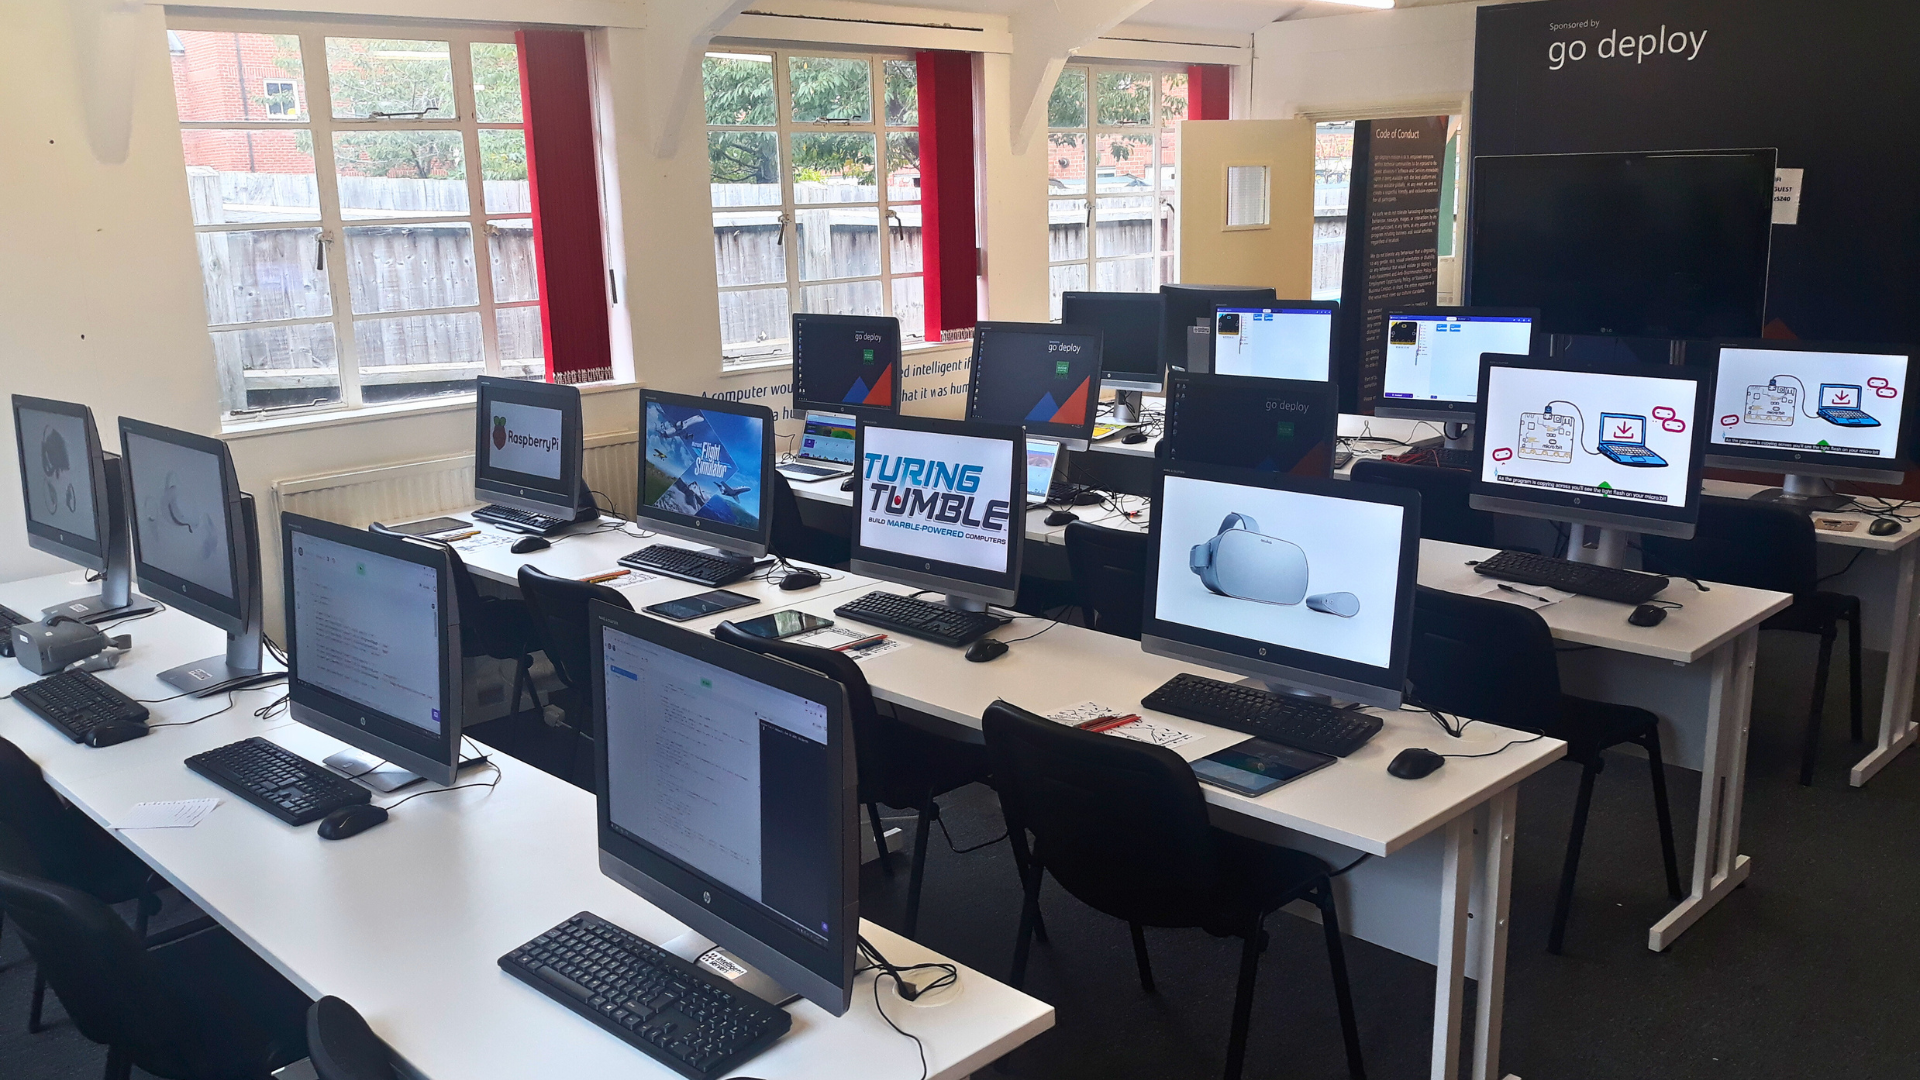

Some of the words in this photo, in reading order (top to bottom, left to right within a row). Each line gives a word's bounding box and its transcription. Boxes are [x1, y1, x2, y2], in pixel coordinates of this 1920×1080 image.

[1549, 19, 1589, 32] Sponsored
[1590, 19, 1600, 28] by
[1548, 40, 1587, 70] go
[1598, 24, 1708, 64] deploy
[1376, 128, 1390, 139] Code
[1391, 128, 1398, 138] of
[1398, 128, 1420, 139] Conduct
[855, 334, 862, 342] go
[863, 333, 882, 343] deploy
[1048, 344, 1057, 353] go
[1058, 343, 1081, 354] deploy
[712, 386, 768, 402] computer
[913, 360, 962, 376] intelligent
[921, 387, 927, 399] it
[1266, 401, 1277, 411] go
[1280, 400, 1310, 414] deploy
[508, 430, 550, 452] Raspberry
[551, 437, 560, 451] Pi
[702, 442, 721, 462] Flight
[694, 457, 727, 478] Simulator
[864, 453, 984, 494] TURING
[869, 483, 1009, 530] TUMBLE
[868, 516, 886, 525] BUILD
[887, 519, 964, 538] MARBLE-POWERED
[965, 533, 1006, 545] COMPUTERS
